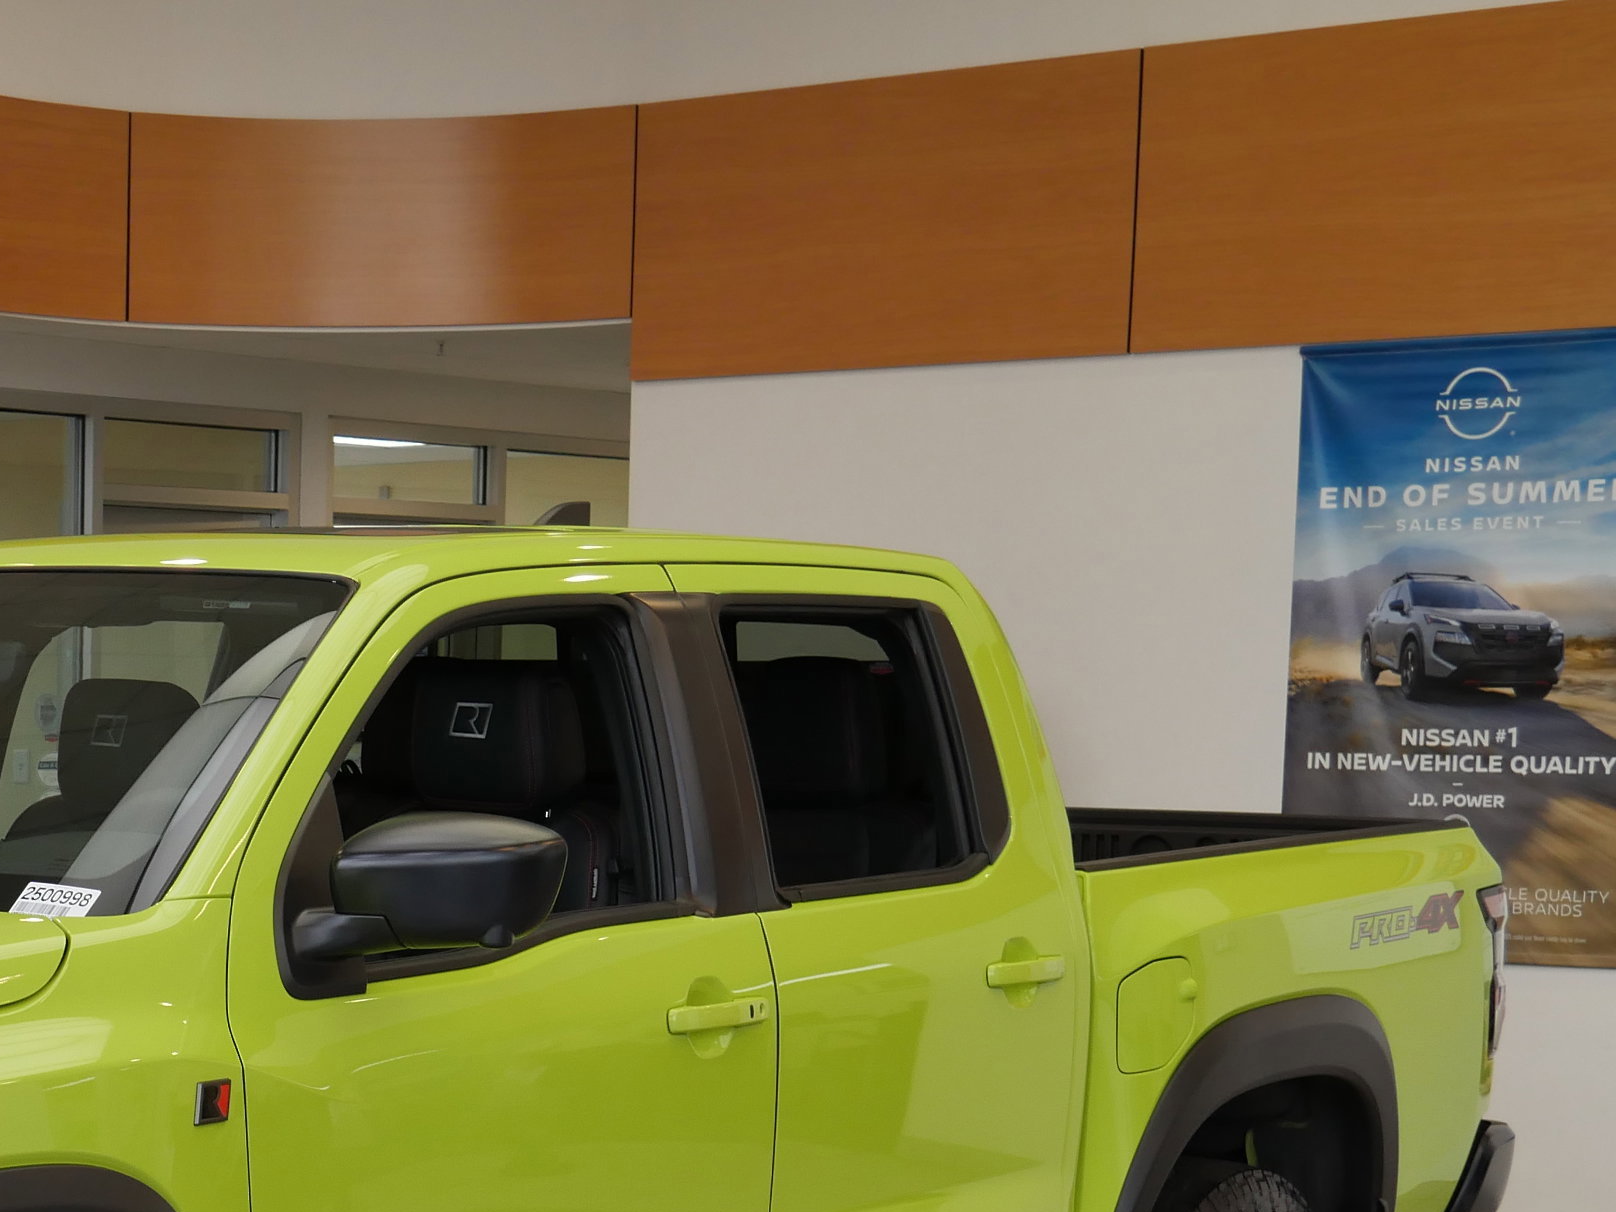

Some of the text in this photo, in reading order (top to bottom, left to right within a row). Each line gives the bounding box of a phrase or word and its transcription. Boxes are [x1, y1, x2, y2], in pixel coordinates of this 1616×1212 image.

[1436, 396, 1521, 411] NISSAN
[1425, 455, 1521, 473] NISSAN
[1319, 486, 1386, 509] END
[1403, 484, 1450, 507] OF
[1396, 516, 1544, 532] SALES EVENT
[1401, 727, 1519, 748] NISSAN #1
[1306, 752, 1616, 776] IN NEW-VEHICLE QUALITY
[1408, 793, 1504, 808] J.D. POWER
[21, 886, 93, 907] 2500998
[1504, 887, 1610, 905] LE QUALITY
[1512, 901, 1582, 918] BRANDS
